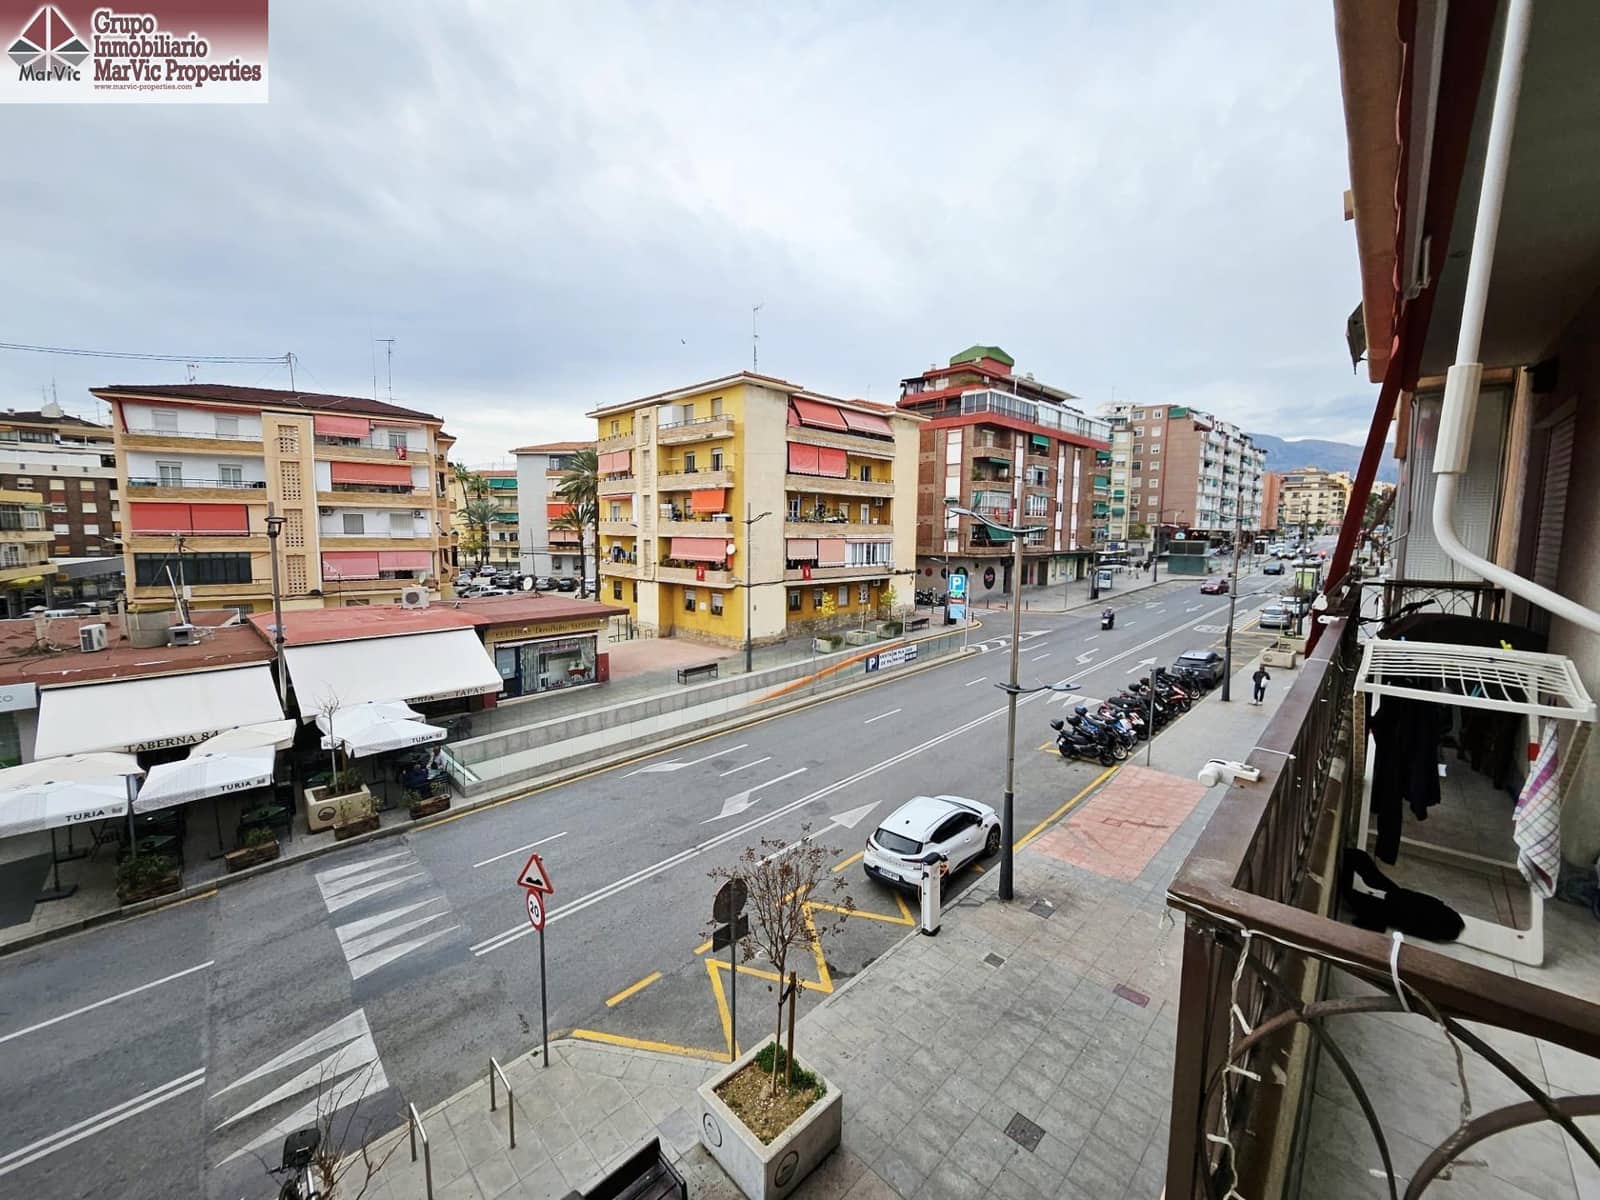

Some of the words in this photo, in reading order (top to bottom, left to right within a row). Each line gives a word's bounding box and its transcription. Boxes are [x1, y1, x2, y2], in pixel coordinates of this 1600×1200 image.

[455, 686, 486, 698] TAPAS
[124, 735, 197, 753] TABERNA
[411, 734, 433, 744] TURIA
[220, 780, 252, 792] TURIA
[65, 809, 105, 823] TURIA
[529, 900, 540, 917] 20
